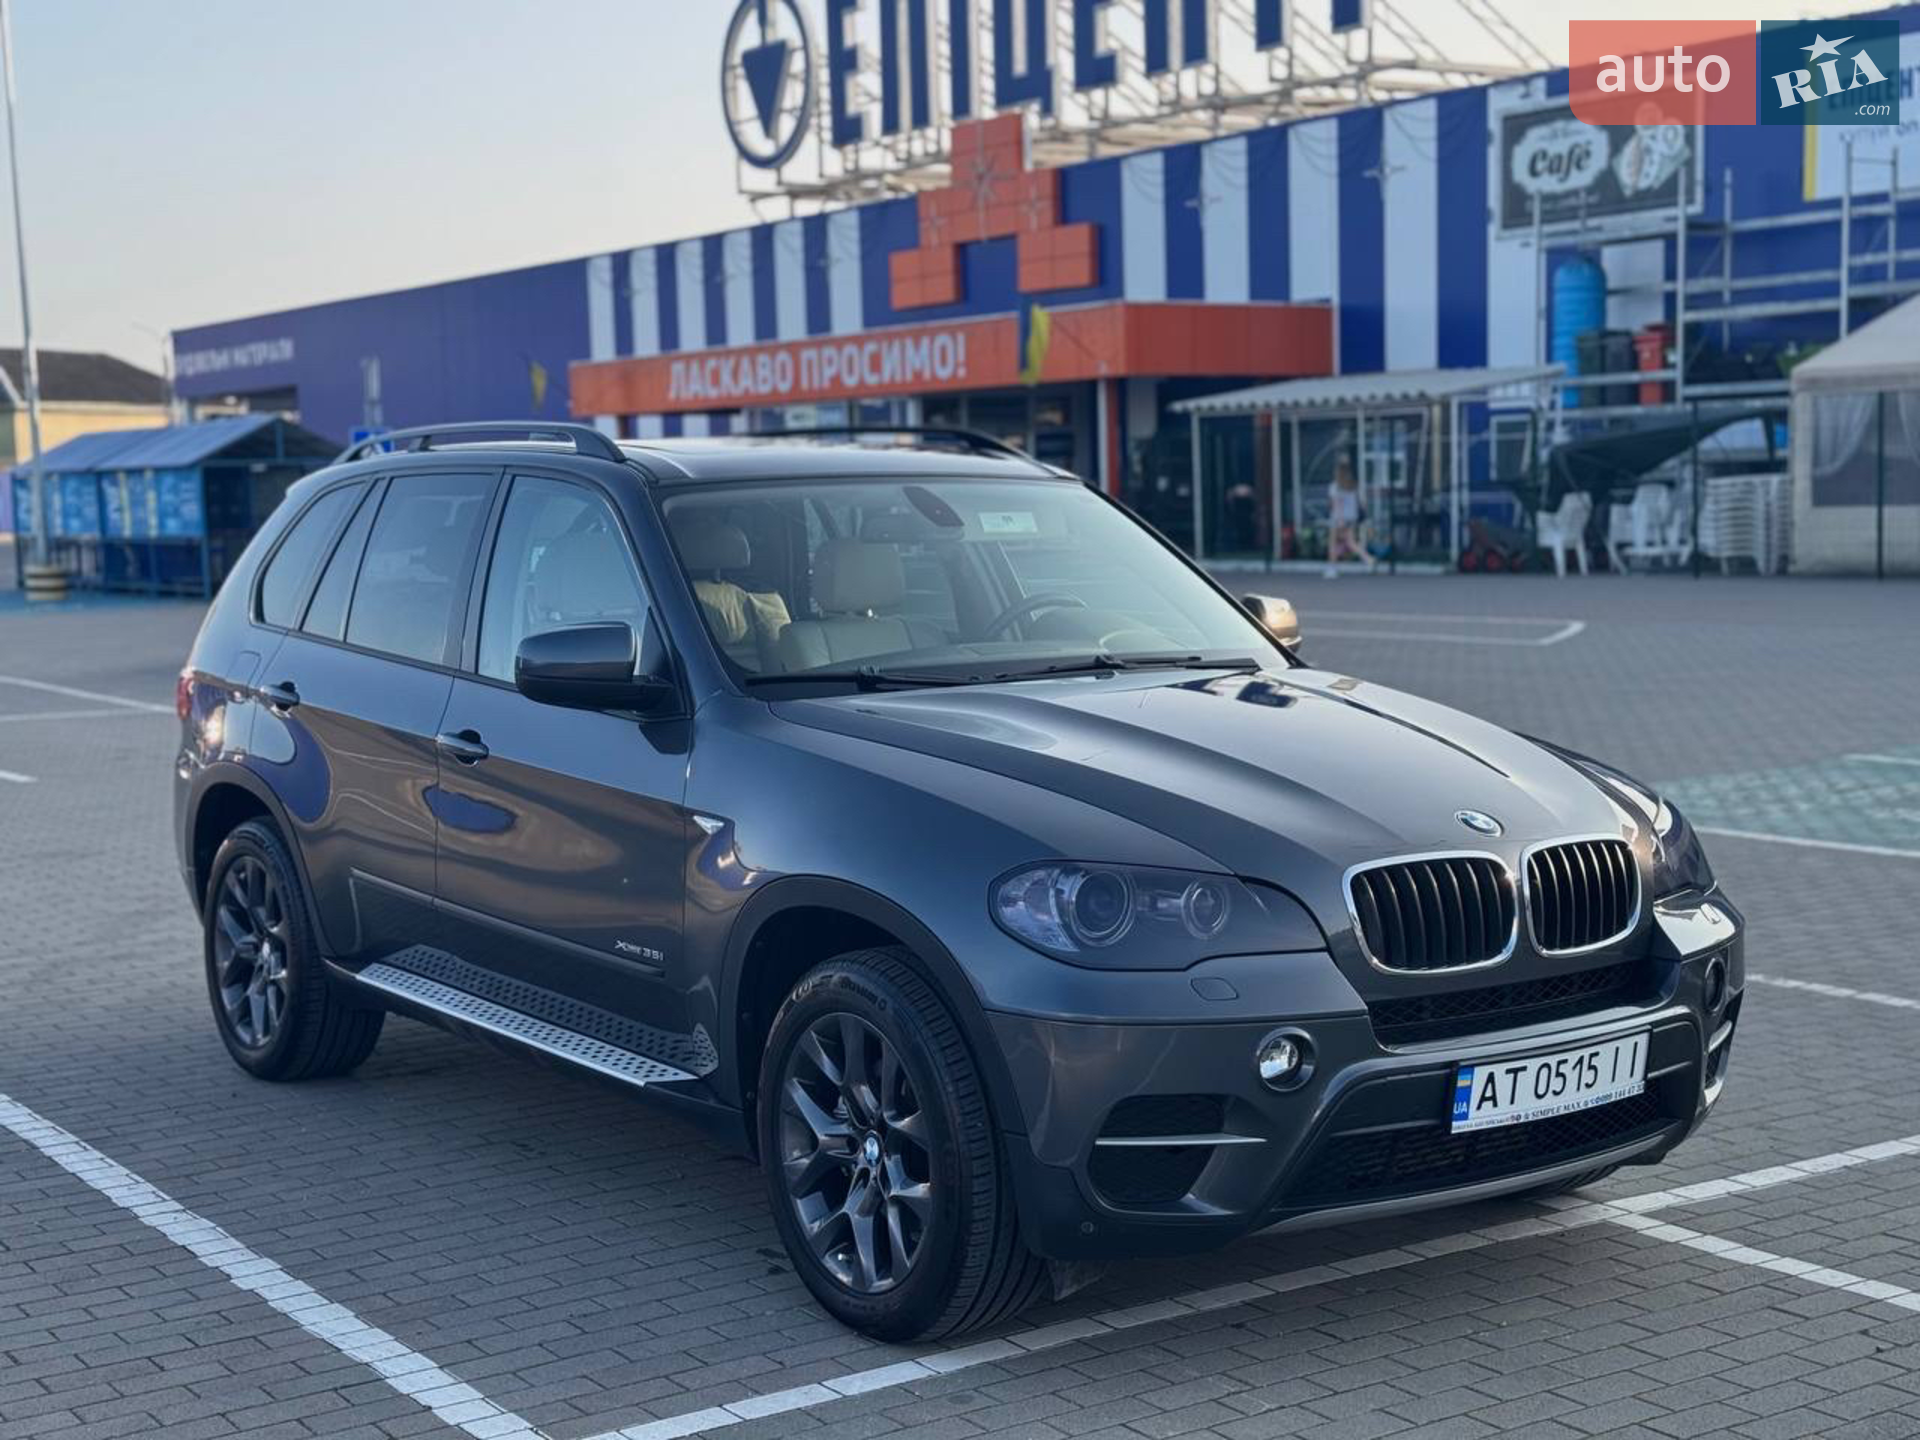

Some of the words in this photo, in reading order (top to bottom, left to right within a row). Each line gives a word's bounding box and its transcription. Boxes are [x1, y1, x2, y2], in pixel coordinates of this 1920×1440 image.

[1528, 140, 1593, 183] Café
[669, 352, 794, 401] ЛАСКАВО
[801, 332, 967, 391] ПРОСИМО!
[1476, 1065, 1528, 1111] AT
[1534, 1051, 1601, 1100] 0515
[1453, 1100, 1468, 1115] UA
